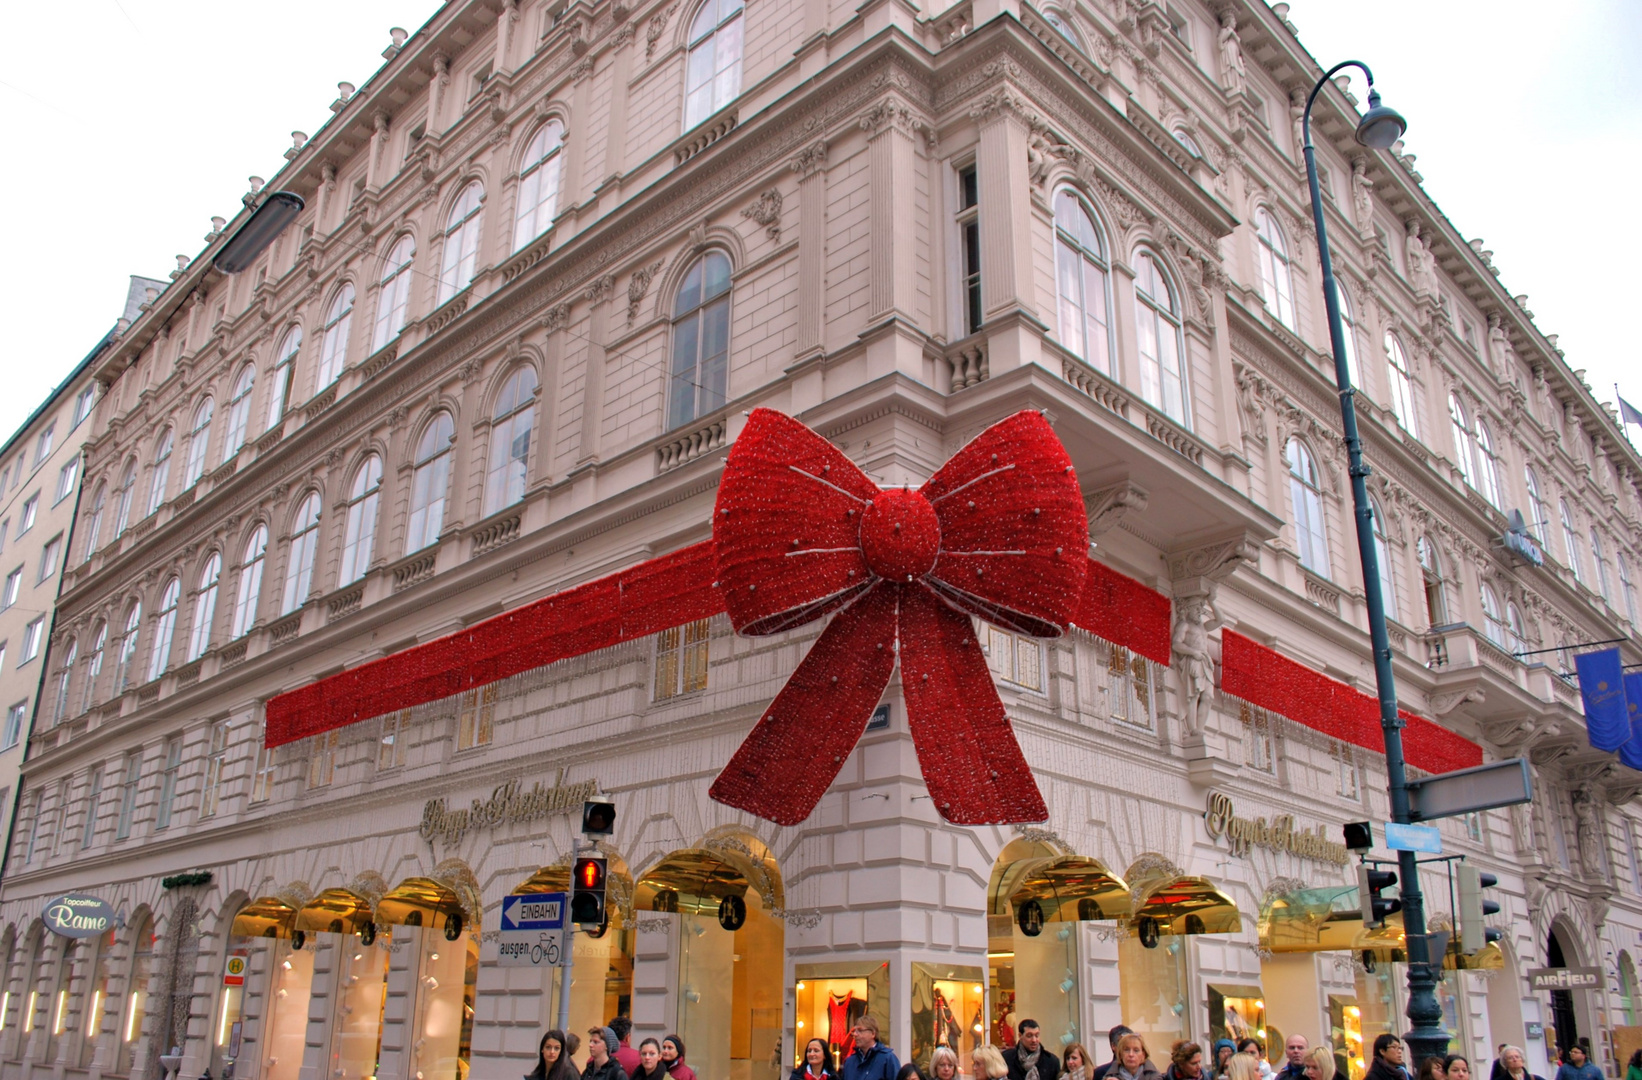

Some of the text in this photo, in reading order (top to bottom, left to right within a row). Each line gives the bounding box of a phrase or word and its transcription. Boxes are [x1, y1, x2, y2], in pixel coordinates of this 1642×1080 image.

[63, 897, 102, 908] Topcoiffeur
[48, 904, 107, 931] Rame
[521, 903, 557, 919] EINBAHN
[500, 942, 531, 959] ausgen.
